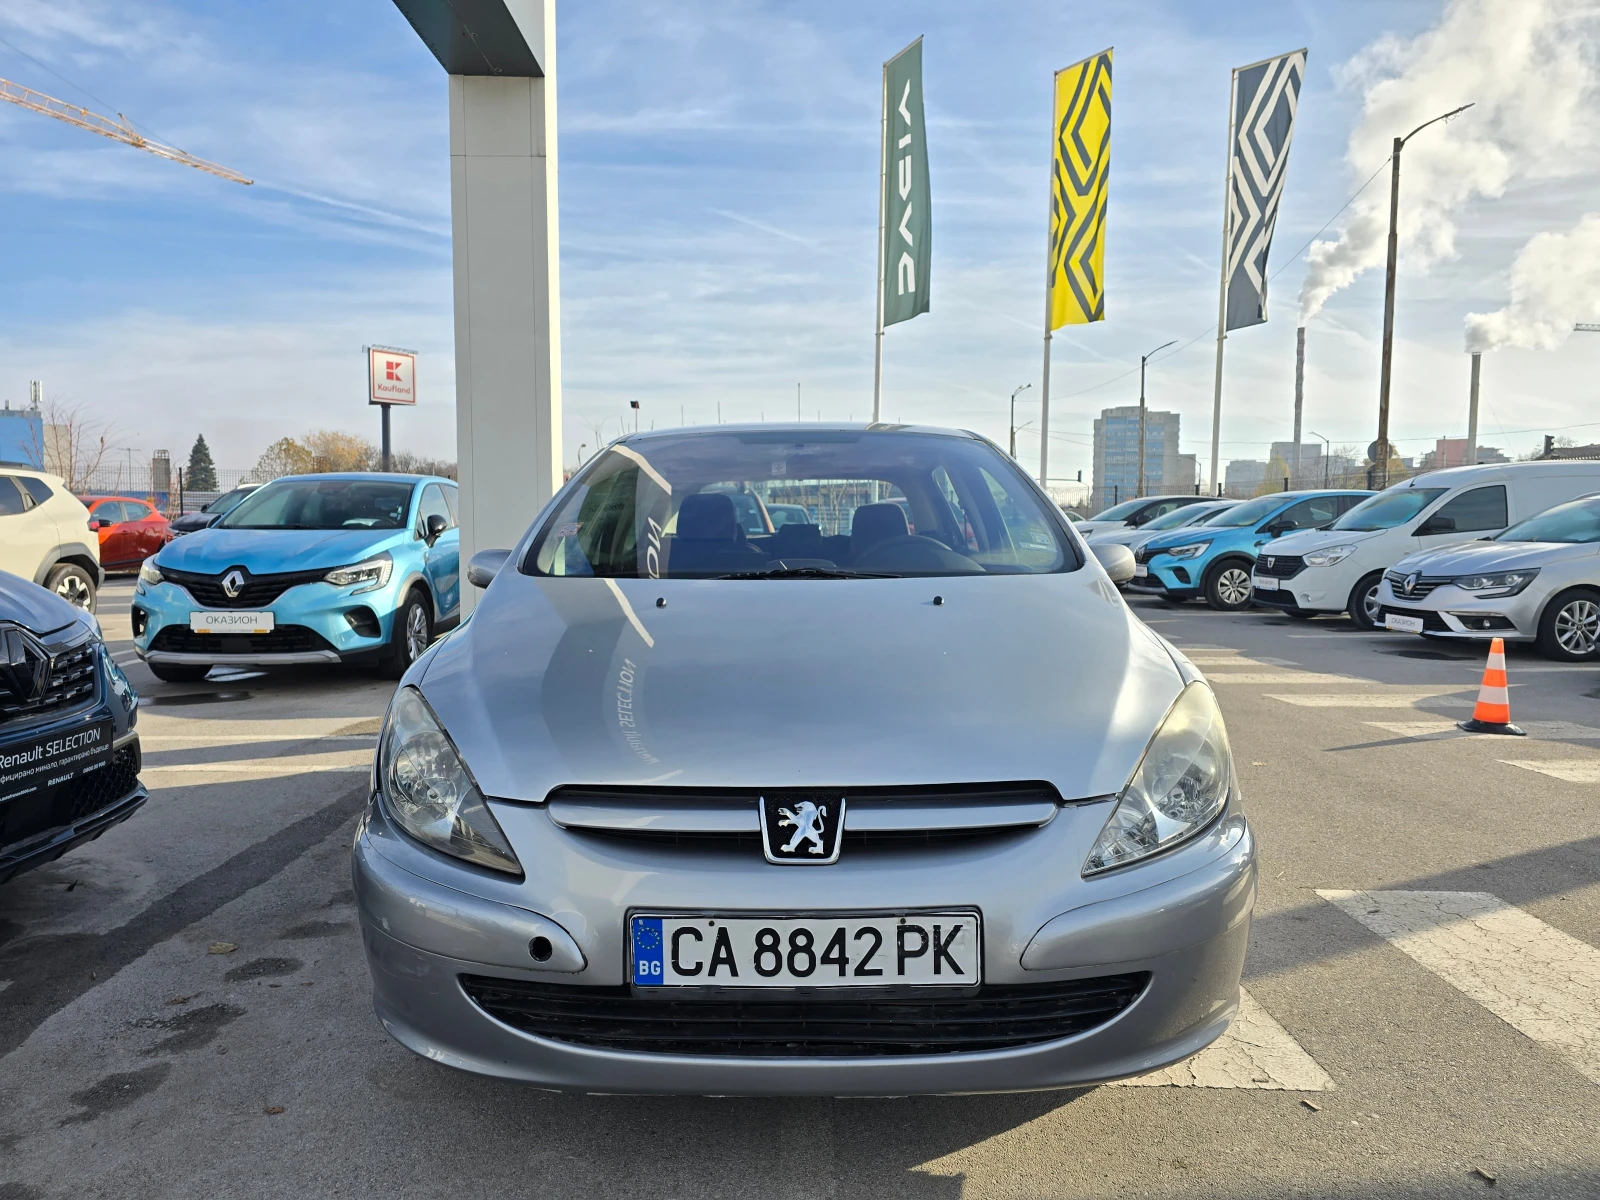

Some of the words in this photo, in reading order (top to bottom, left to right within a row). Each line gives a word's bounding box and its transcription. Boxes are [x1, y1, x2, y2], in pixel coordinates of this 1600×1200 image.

[898, 79, 916, 296] DACIA
[377, 383, 411, 394] Kaufland
[206, 616, 258, 625] ОКАЗИОН
[0, 745, 44, 769] Renault
[45, 727, 101, 757] SELECTION
[47, 772, 74, 786] RENAULT
[671, 926, 739, 977] CA
[753, 926, 884, 978] 8842
[897, 924, 965, 976] PK
[639, 960, 661, 976] BG
